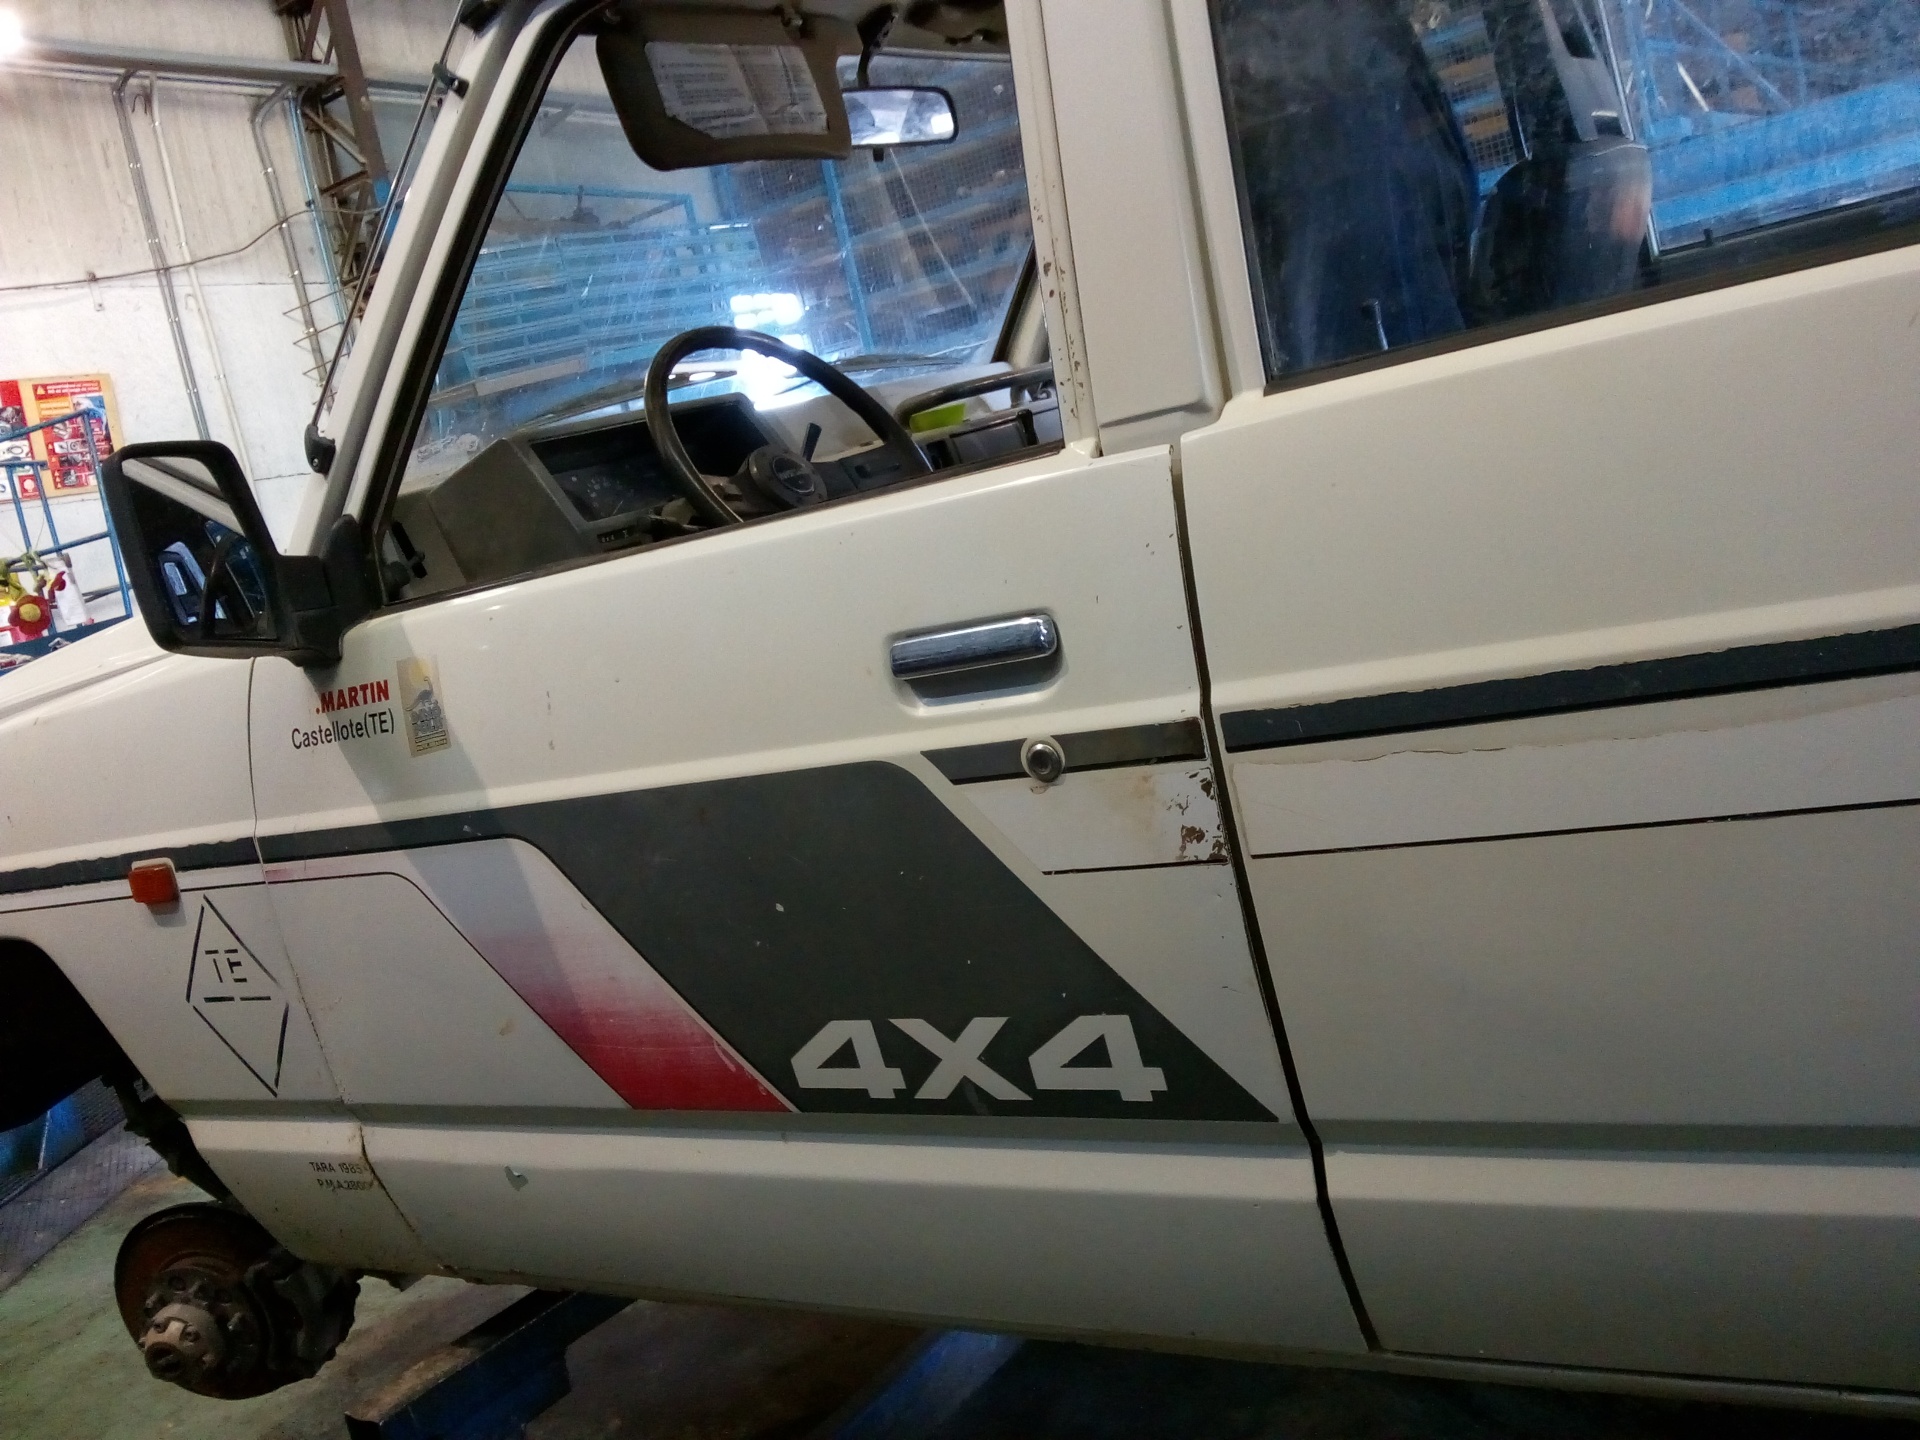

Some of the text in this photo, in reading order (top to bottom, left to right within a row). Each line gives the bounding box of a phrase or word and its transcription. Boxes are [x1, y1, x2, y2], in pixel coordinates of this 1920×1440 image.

[291, 708, 395, 750] Castellote(TE)
[204, 948, 248, 984] TE
[790, 1013, 1168, 1103] 4X4
[308, 1161, 336, 1174] TARA
